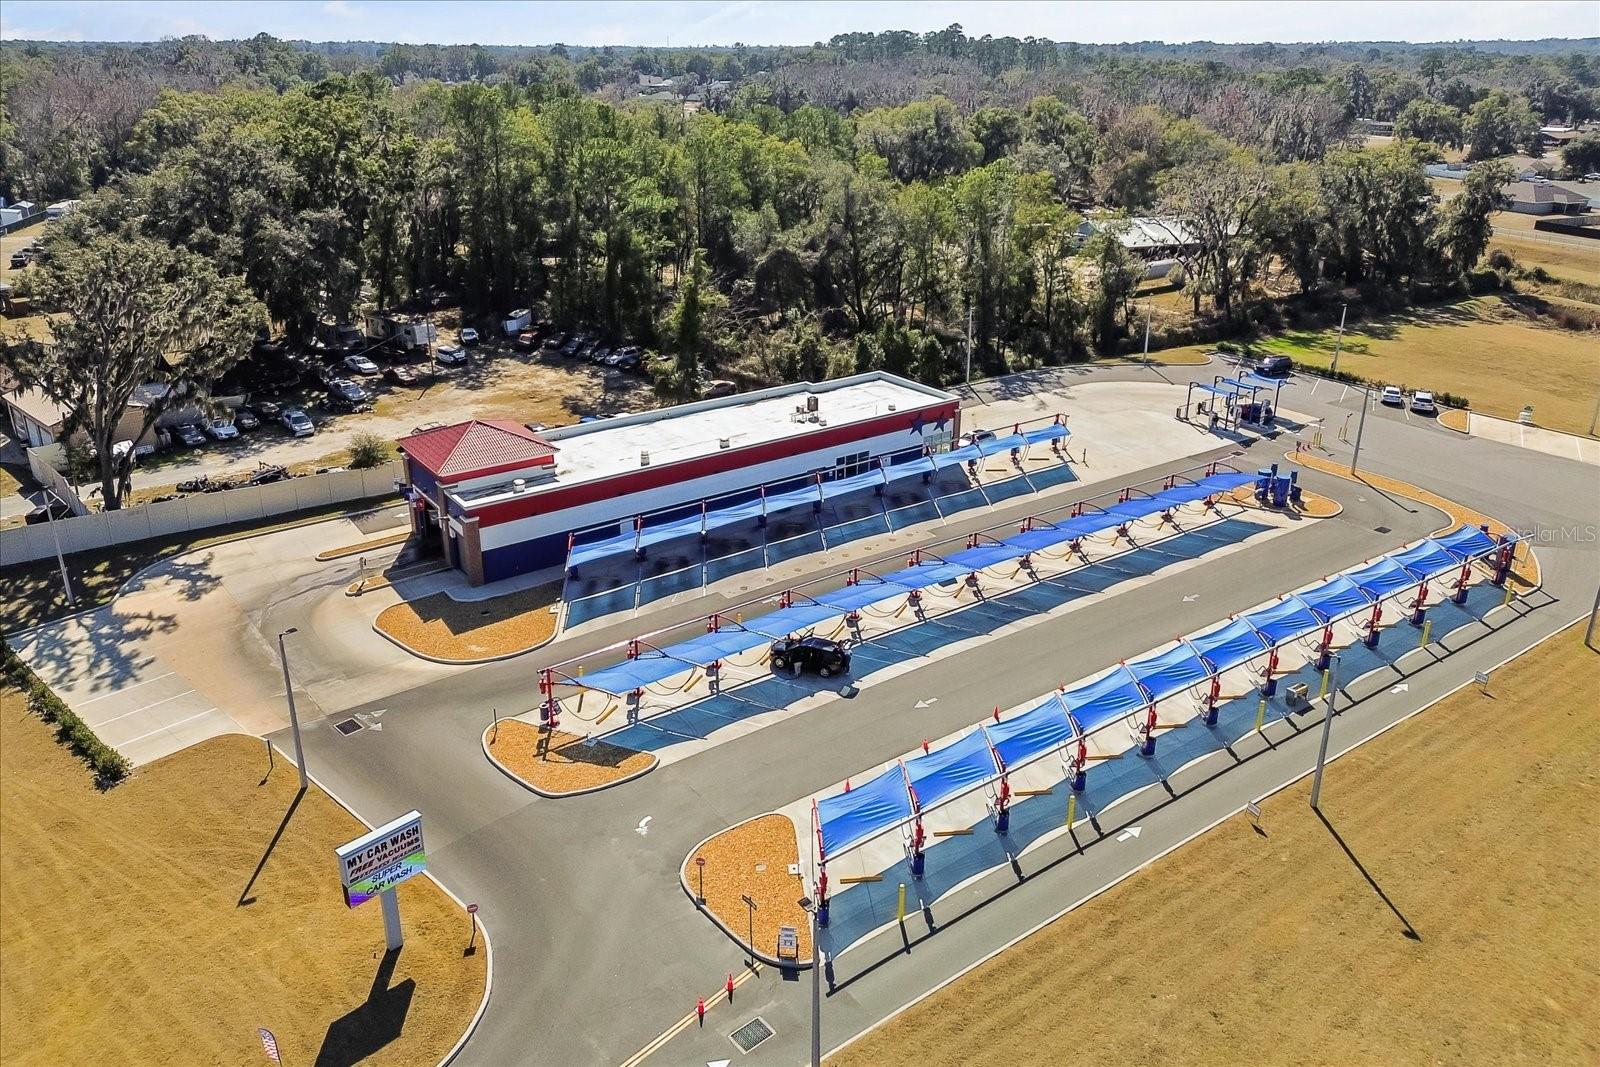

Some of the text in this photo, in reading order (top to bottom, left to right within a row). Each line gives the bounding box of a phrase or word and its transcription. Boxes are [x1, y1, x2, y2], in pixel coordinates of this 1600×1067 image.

[346, 825, 419, 869] MY CAR WASH
[349, 836, 420, 878] FREE VACUUMS
[366, 865, 412, 895] CAR WASH
[371, 862, 402, 883] SUPER
